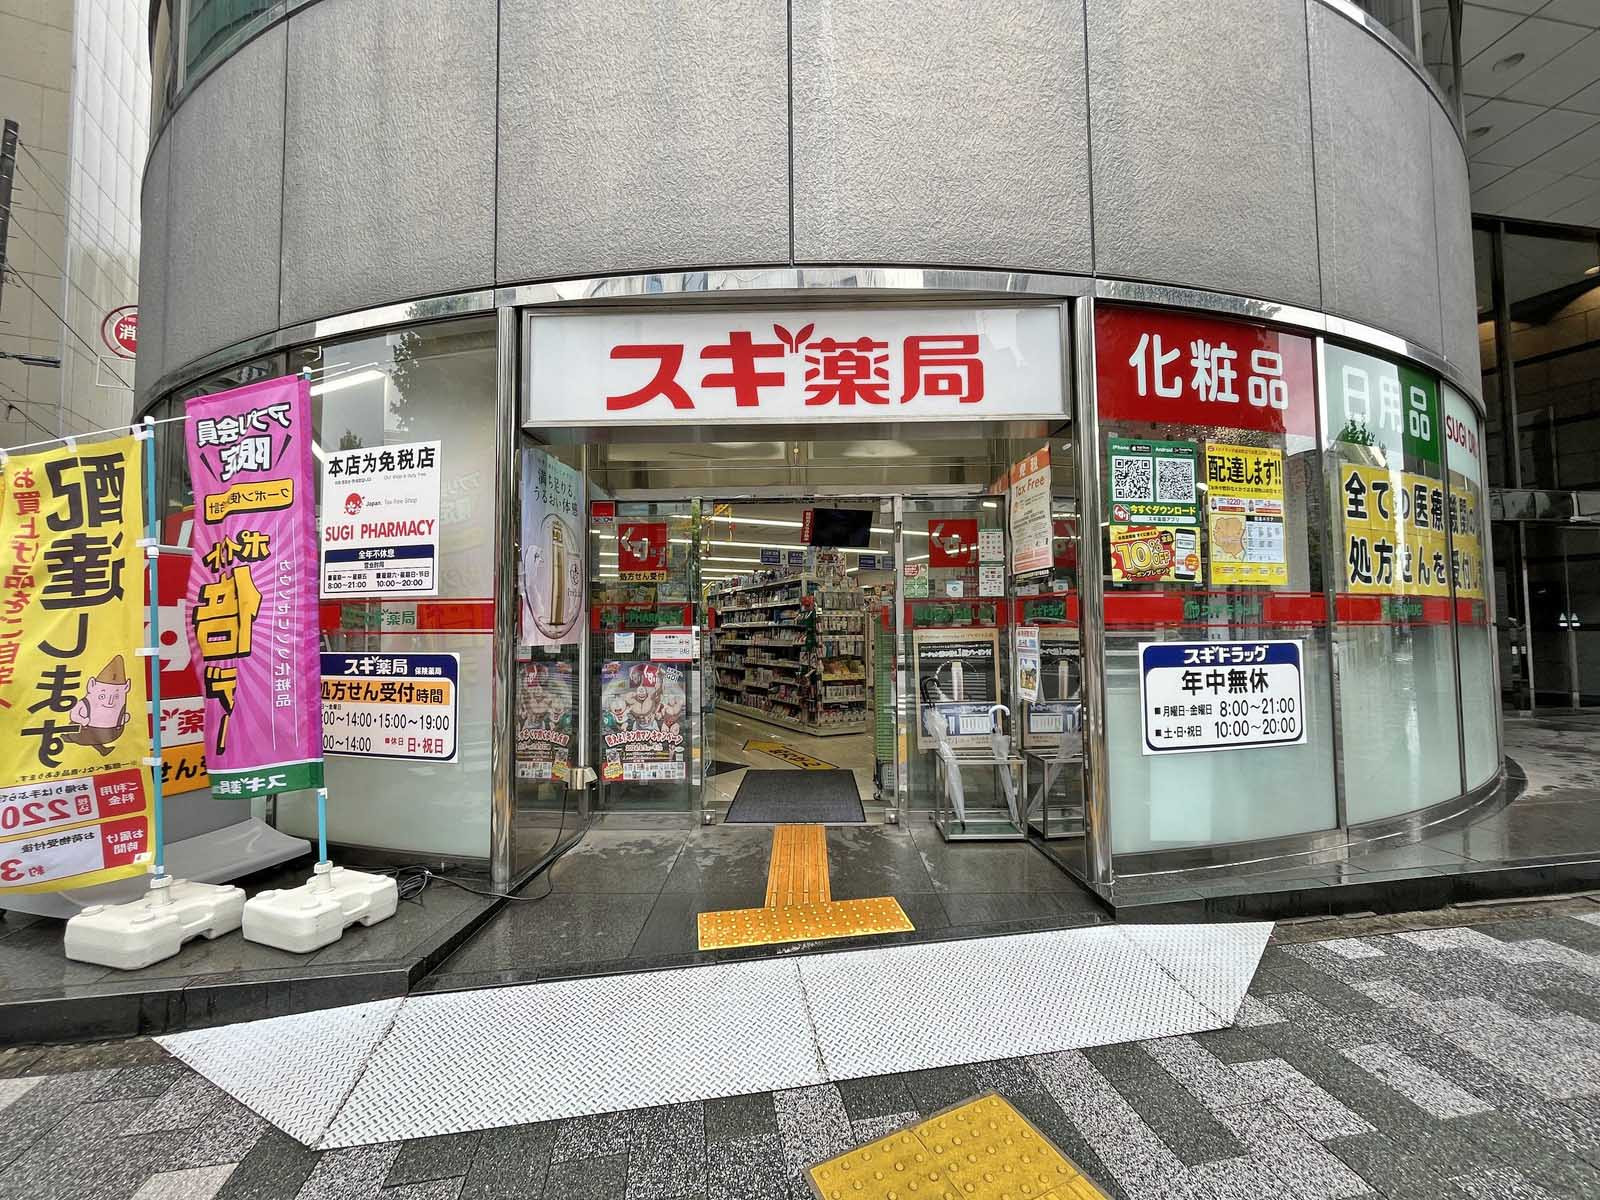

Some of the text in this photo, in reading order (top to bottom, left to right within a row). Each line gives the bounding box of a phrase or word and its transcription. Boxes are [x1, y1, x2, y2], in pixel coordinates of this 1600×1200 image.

[606, 323, 985, 411] スギ薬局
[1128, 333, 1289, 410] 化粧品
[1341, 364, 1431, 441] 日用品
[1445, 415, 1466, 449] SUGI
[328, 446, 436, 478] 本店为免税店
[1027, 476, 1046, 490] Free
[1130, 505, 1196, 515] 今すぐダウンロード
[325, 519, 435, 542] SUGI PHARMACY
[358, 548, 395, 560] 全年不休息
[619, 573, 665, 581] 処方せん受付
[344, 655, 408, 676] スギ薬局
[1183, 645, 1270, 665] スギドラッグ
[1181, 667, 1269, 696] 年中無休
